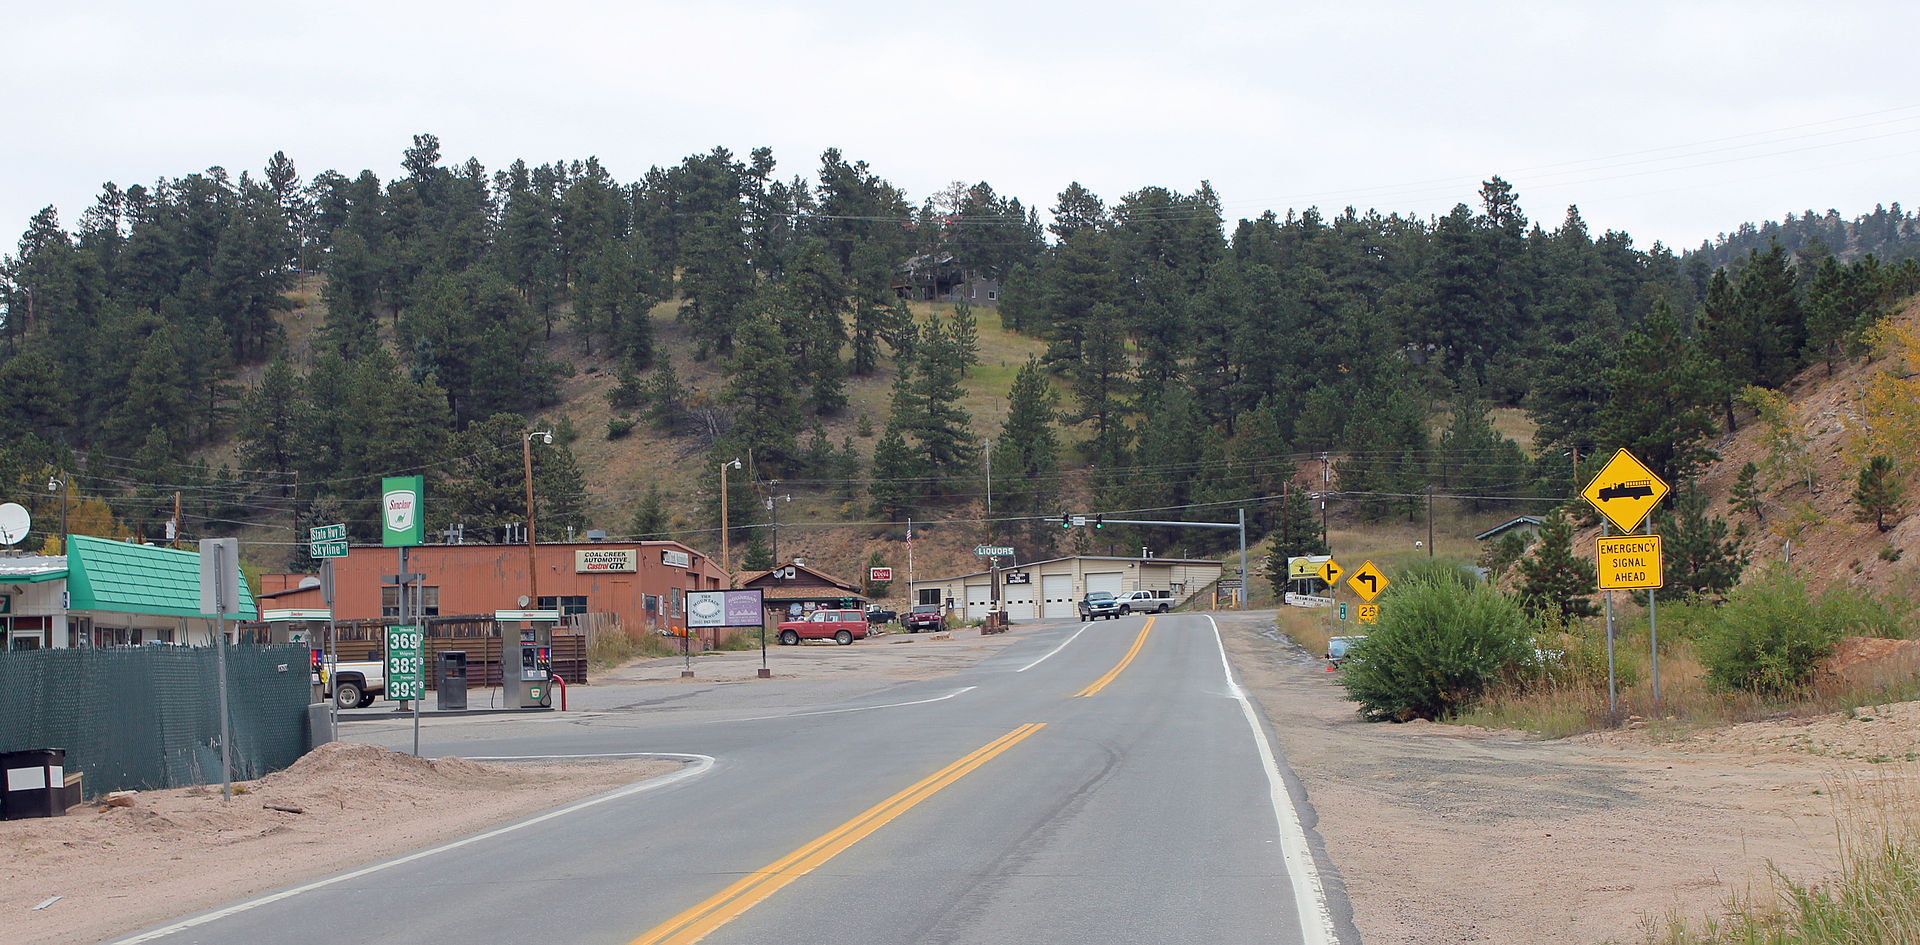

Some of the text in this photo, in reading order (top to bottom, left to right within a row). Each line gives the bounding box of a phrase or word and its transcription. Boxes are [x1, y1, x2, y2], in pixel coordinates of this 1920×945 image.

[390, 500, 411, 510] Sinclair
[312, 525, 346, 540] State Hwy 72
[312, 543, 340, 556] Skyline
[978, 547, 1014, 555] LIQUORS
[1600, 543, 1656, 554] EMERGENCY
[1612, 557, 1647, 568] SIGNAL
[1615, 571, 1646, 582] AHEAD
[1361, 606, 1376, 617] 25
